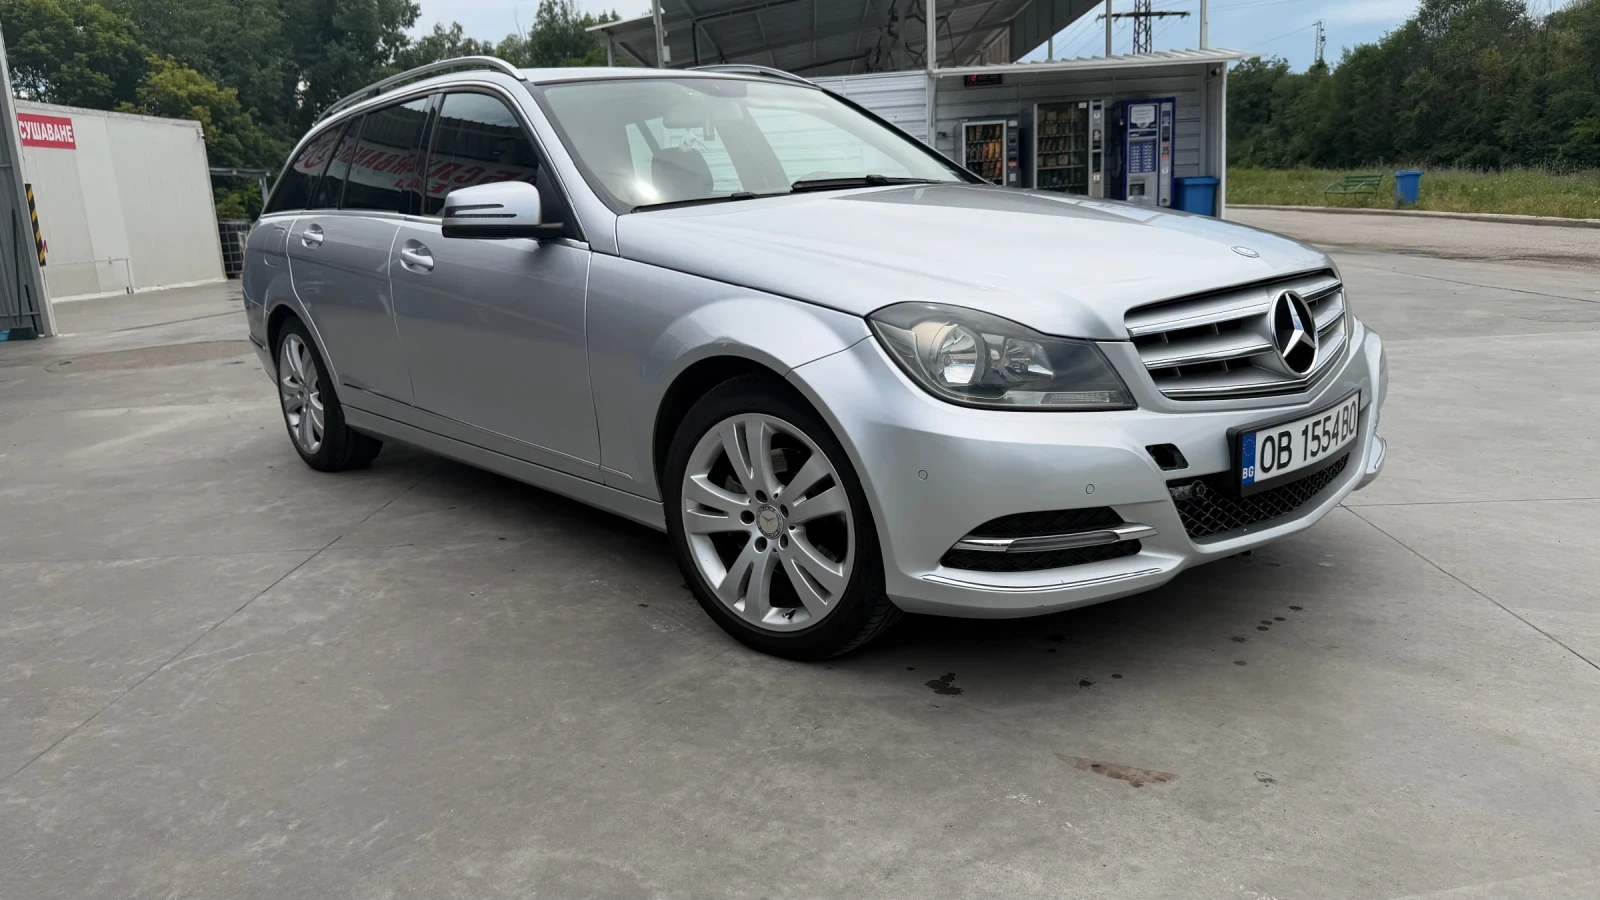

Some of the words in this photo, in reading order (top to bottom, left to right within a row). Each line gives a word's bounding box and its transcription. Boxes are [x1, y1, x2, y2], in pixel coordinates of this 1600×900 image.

[18, 120, 73, 142] СУШАВАНЕ
[1260, 430, 1293, 474] OB
[1242, 465, 1255, 479] BG
